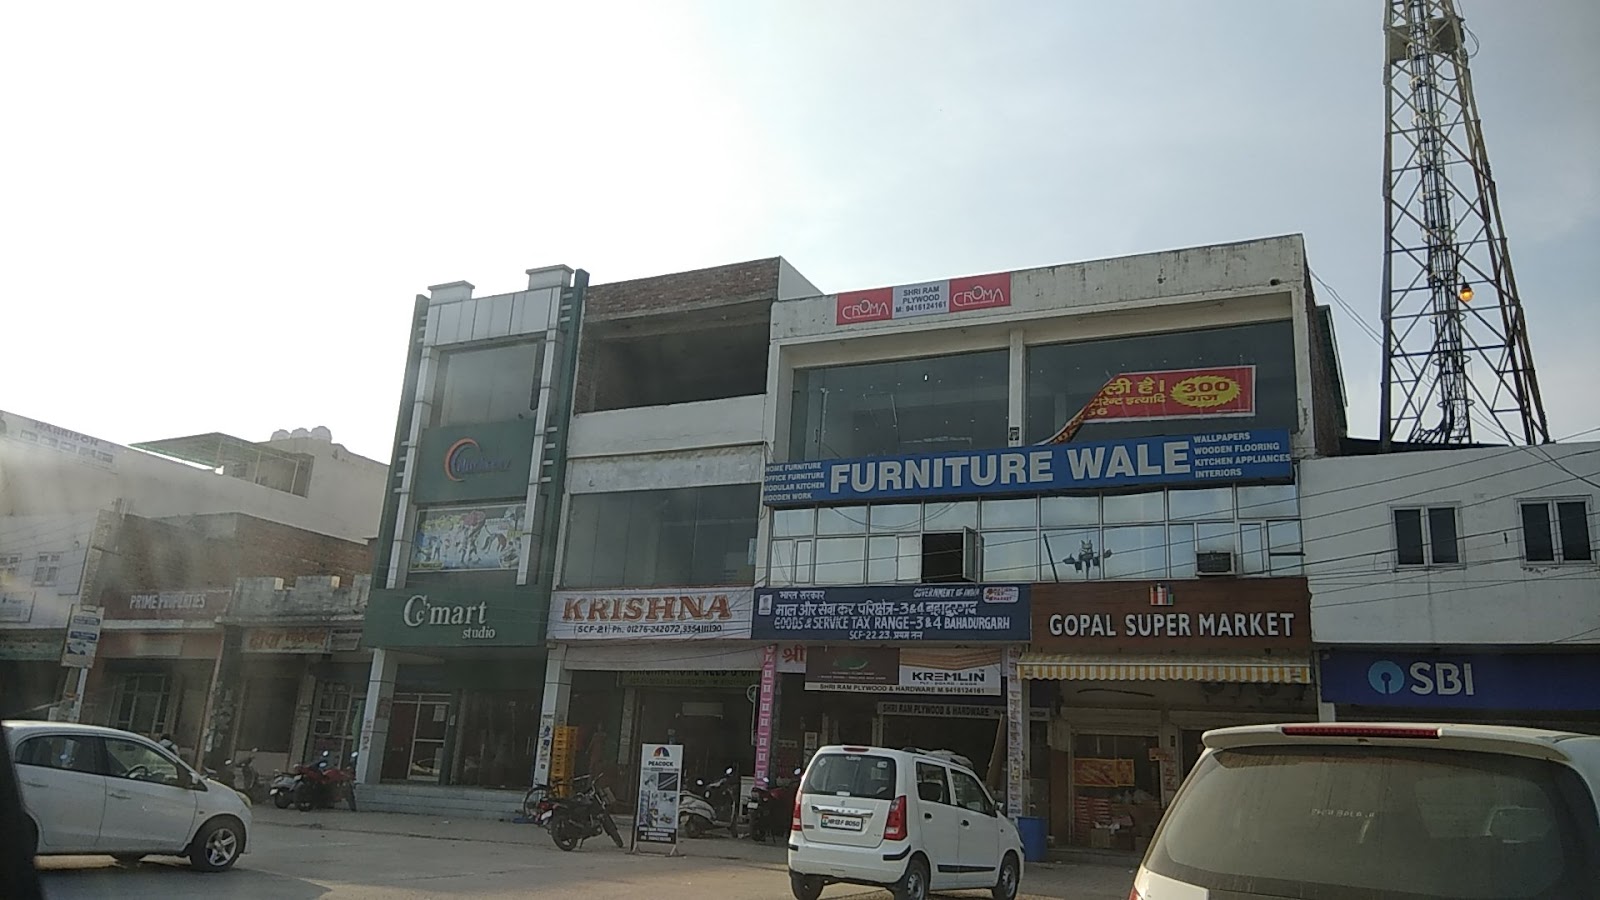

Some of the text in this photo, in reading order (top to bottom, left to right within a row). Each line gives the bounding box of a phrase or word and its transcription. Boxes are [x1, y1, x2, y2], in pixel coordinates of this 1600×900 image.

[903, 286, 940, 297] SHRI RAM
[953, 285, 1004, 307] CROMA
[902, 294, 940, 304] PLYWOOD
[842, 299, 889, 320] CROMA
[1182, 381, 1230, 393] 300
[1193, 432, 1251, 443] WALLPAPERS
[1194, 442, 1280, 455] WOODEN FLOORING
[1194, 453, 1292, 467] KITCHEN APPLIANCES
[784, 462, 822, 471] FURNITURE
[829, 441, 1191, 494] FURNITURE WALE
[787, 472, 825, 480] FURNITURE
[1195, 468, 1242, 478] INTERIORS
[795, 482, 826, 490] KITCHEN
[792, 492, 813, 500] WORK
[779, 590, 825, 600] भारत सरकार
[913, 587, 955, 598] GOVERNMENT
[129, 594, 158, 609] PRIME
[562, 594, 733, 622] KRISHNA
[775, 603, 798, 616] माल
[798, 601, 818, 616] और
[837, 602, 855, 616] कर
[774, 616, 804, 630] GOODS
[804, 617, 812, 629] &
[812, 616, 849, 630] SERVICE
[851, 616, 871, 629] TAX
[944, 616, 1010, 630] BAHADURGARH
[1048, 612, 1295, 637] GOPAL SUPER MARKET
[462, 626, 496, 639] studio
[912, 671, 985, 682] KREMLIN
[1409, 661, 1475, 696] SBI
[895, 685, 937, 693] HARDWARE
[882, 703, 898, 713] SHRI
[898, 703, 914, 713] RAM
[914, 704, 944, 715] PLYWOOD
[952, 704, 990, 716] HARDWARE
